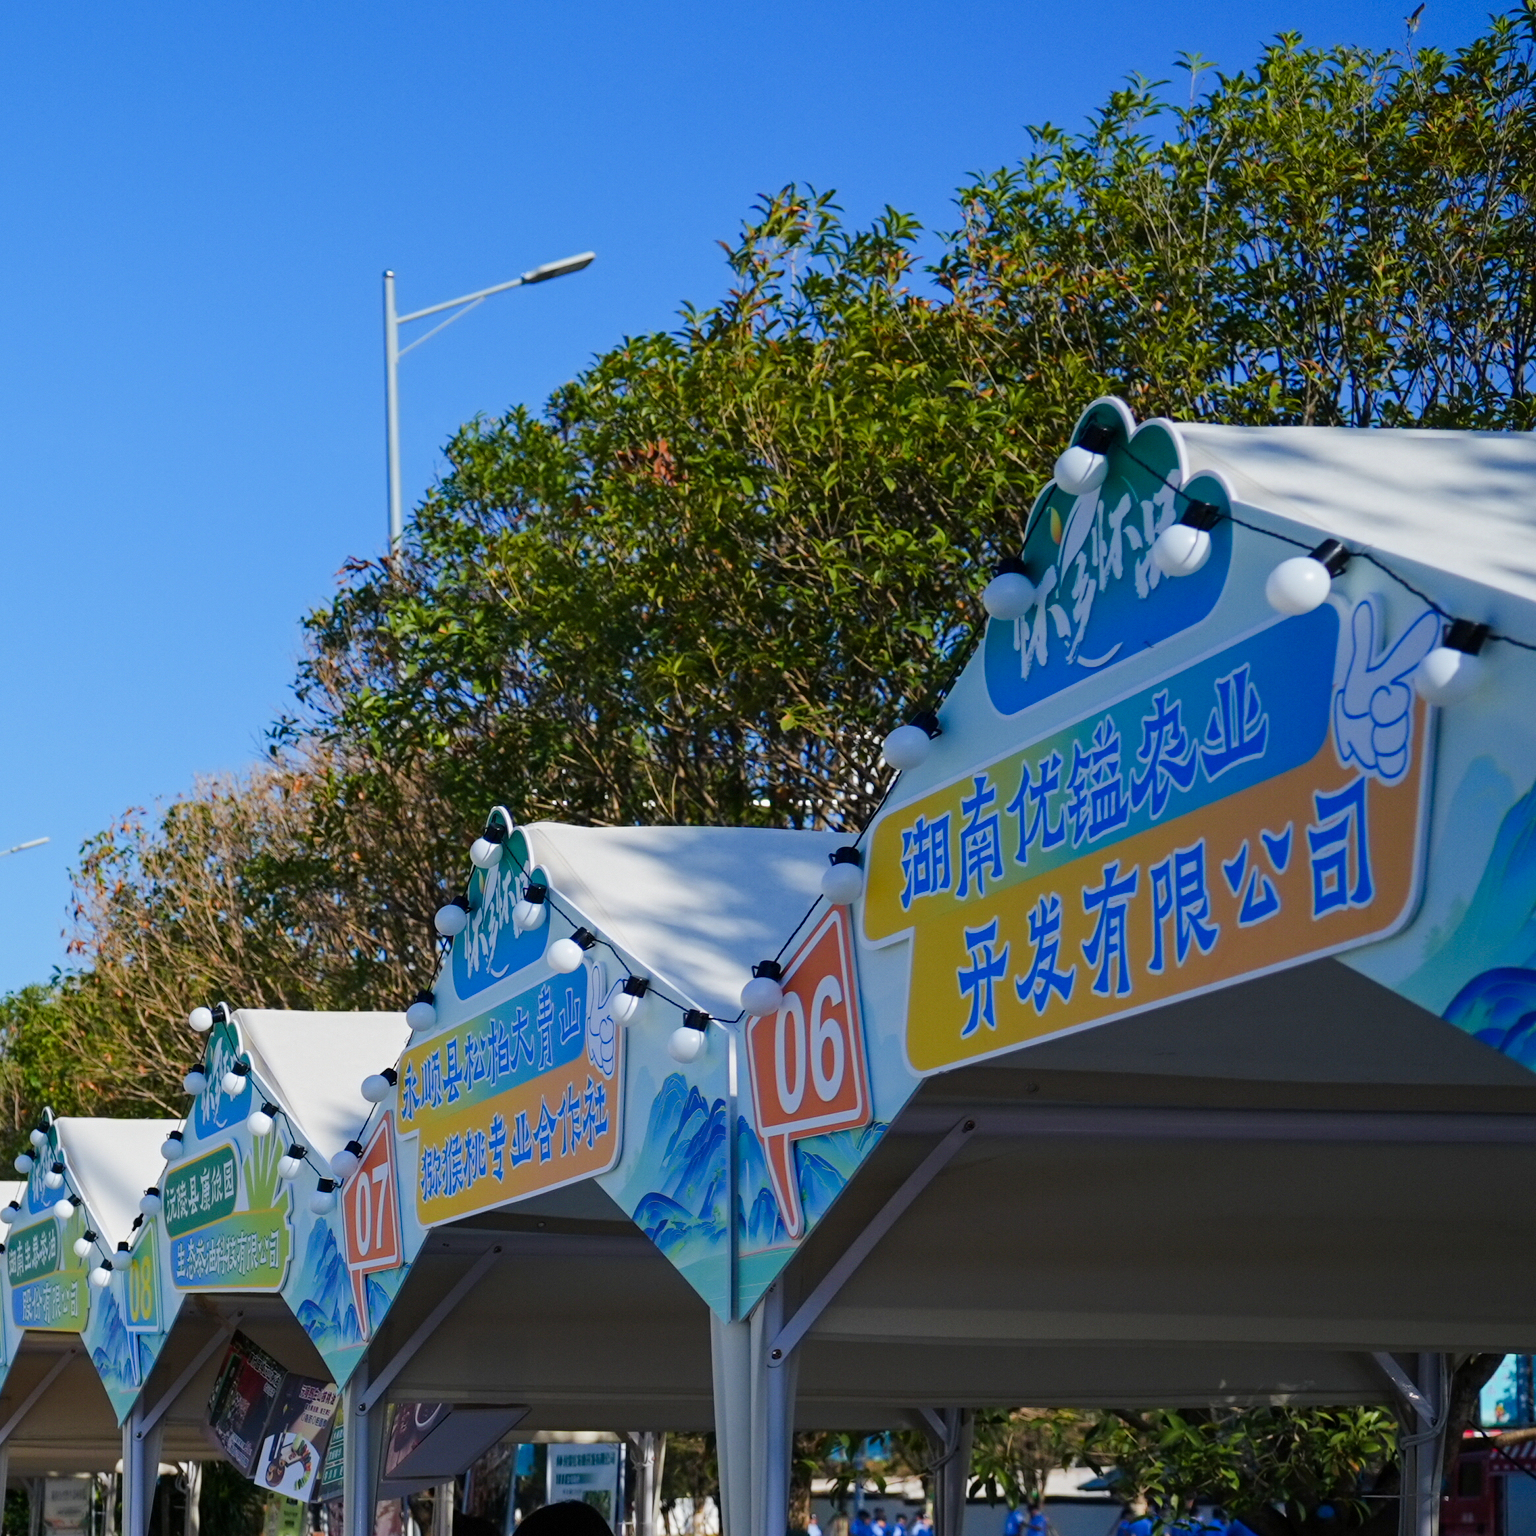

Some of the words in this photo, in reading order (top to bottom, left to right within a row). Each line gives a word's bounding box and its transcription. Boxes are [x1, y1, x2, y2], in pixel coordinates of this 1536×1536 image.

[958, 775, 1373, 1040] 开发有限公司
[401, 984, 581, 1122] 永顺县松柏大青山
[772, 978, 845, 1116] 06
[420, 1076, 608, 1202] 猕猴桃专业合作社
[356, 1165, 389, 1256] 07
[129, 1256, 152, 1322] 08
